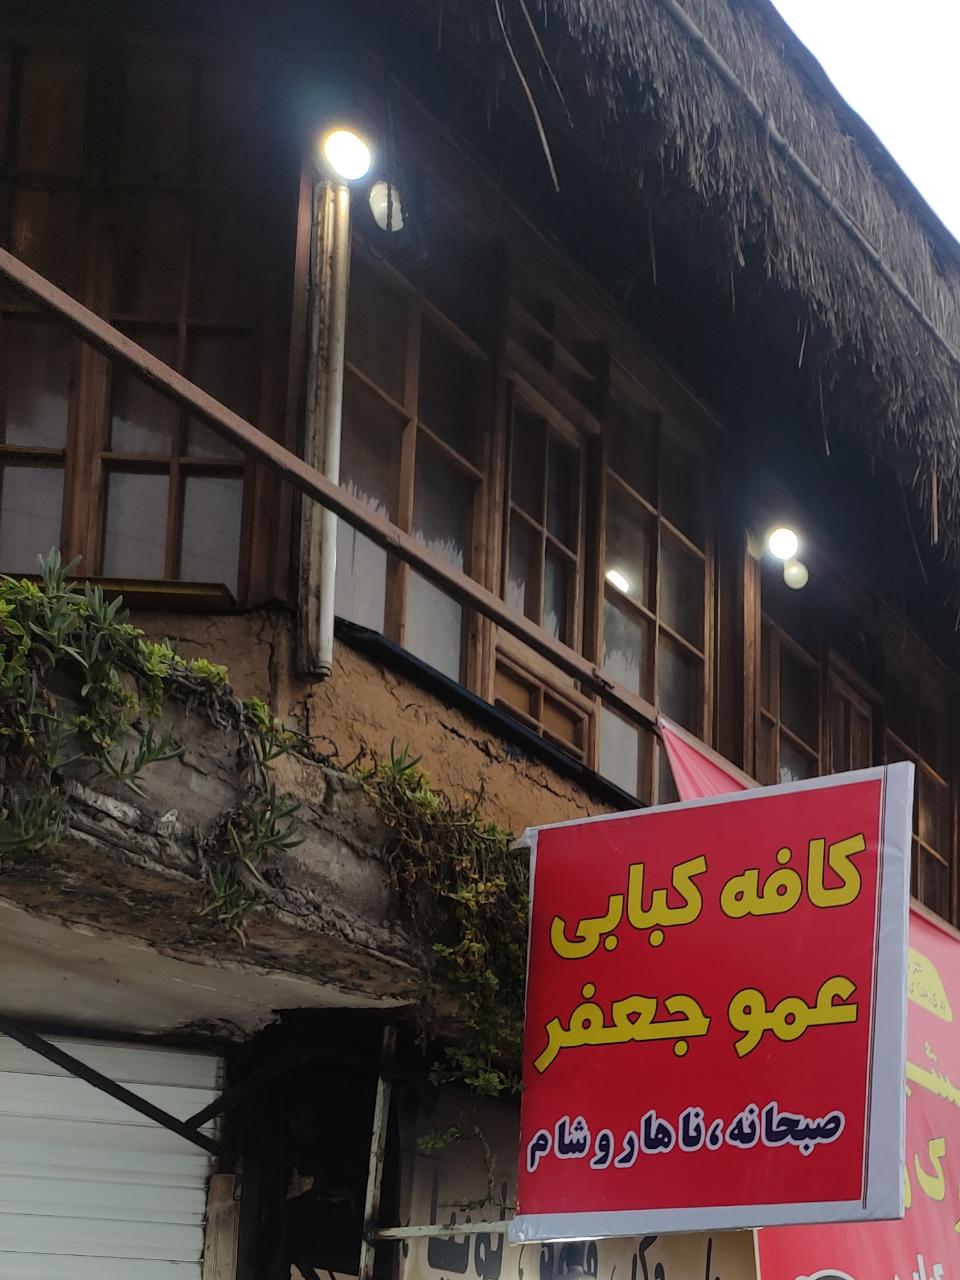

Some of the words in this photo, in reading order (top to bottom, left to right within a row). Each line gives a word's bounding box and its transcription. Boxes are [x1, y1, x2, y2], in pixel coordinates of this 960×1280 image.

[549, 855, 707, 960] کبابی
[719, 833, 867, 919] کافه
[533, 982, 711, 1074] جعفر
[728, 976, 857, 1058] عمو
[526, 1115, 592, 1173] شام
[589, 1128, 615, 1169] و
[613, 1106, 705, 1169] ناهار
